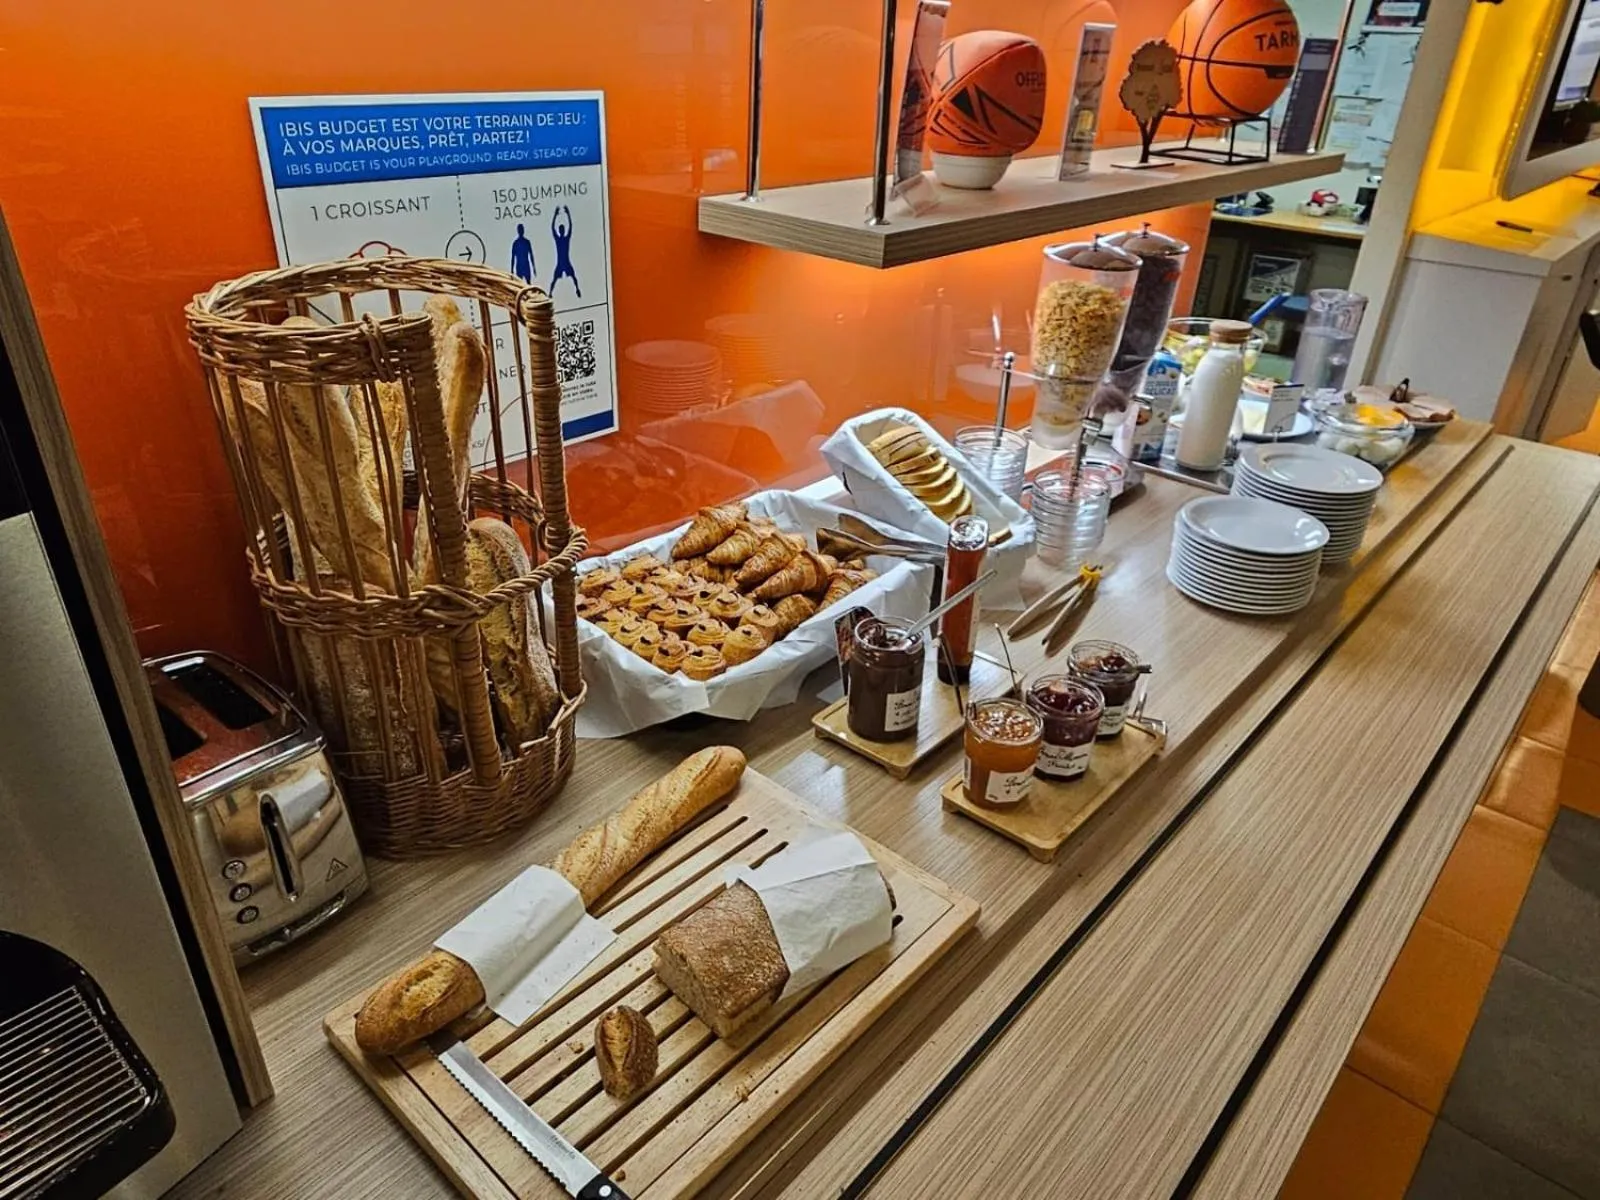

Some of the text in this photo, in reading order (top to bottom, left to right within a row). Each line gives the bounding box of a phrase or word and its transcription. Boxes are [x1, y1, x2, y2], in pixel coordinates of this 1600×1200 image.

[280, 122, 314, 137] IBIS
[319, 119, 387, 136] BUDGET
[392, 118, 419, 132] EST
[423, 116, 472, 131] VOTRE
[475, 114, 533, 129] TERRAIN
[537, 113, 554, 126] DE
[283, 138, 296, 156] À
[299, 139, 335, 155] VOS
[340, 136, 425, 153] MARQUES,
[429, 131, 469, 148] PRÊT,
[287, 163, 312, 176] IBIS
[315, 160, 366, 174] BUDGET
[370, 159, 381, 170] IS
[383, 157, 416, 169] YOUR
[492, 182, 588, 203] 150 JUMPING
[310, 196, 430, 221] 1 CROISSANT
[494, 203, 541, 220] JACKS
